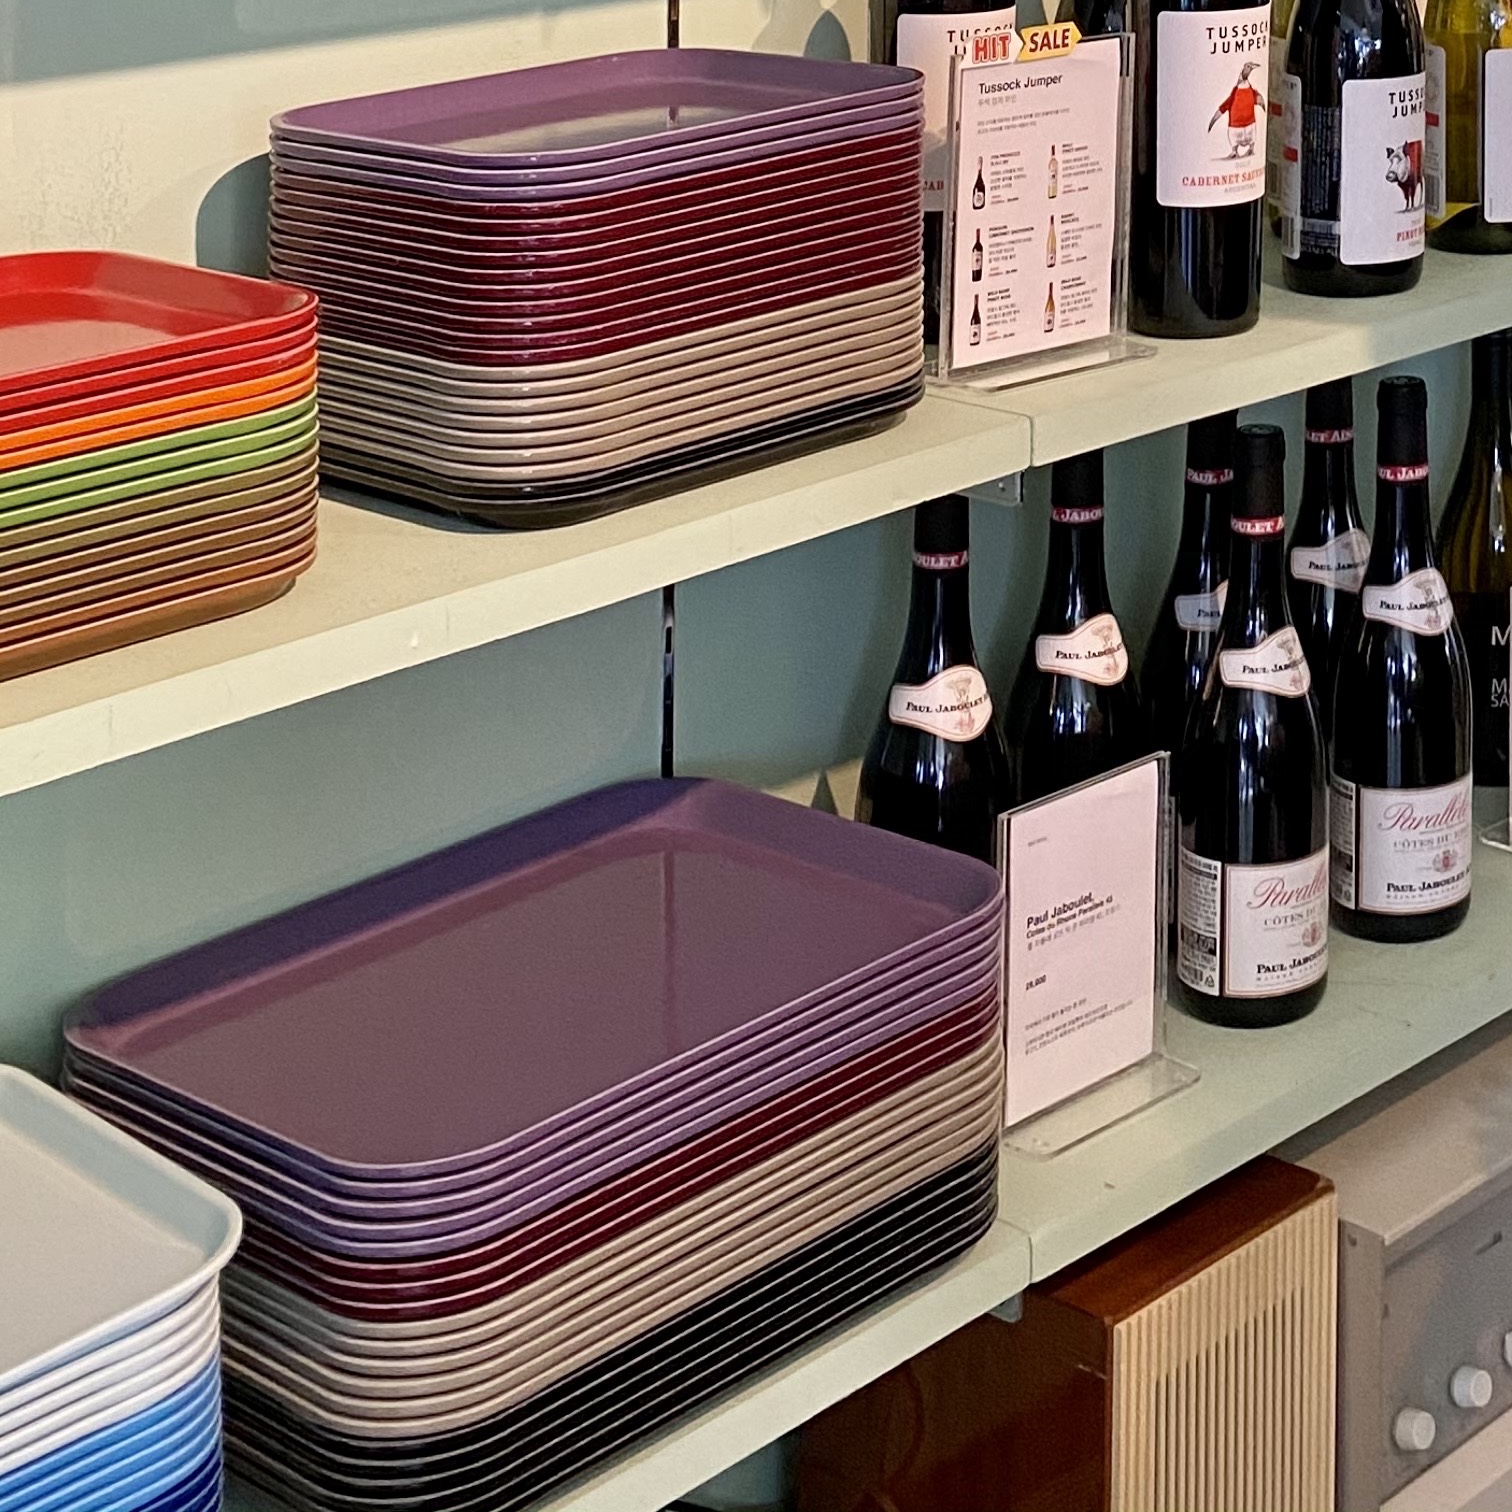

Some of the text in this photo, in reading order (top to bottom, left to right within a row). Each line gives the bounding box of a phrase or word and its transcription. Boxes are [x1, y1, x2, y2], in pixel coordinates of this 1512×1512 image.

[972, 31, 1011, 65] HIT
[1028, 28, 1071, 53] SALE
[978, 74, 1063, 95] Tussock Jumper
[1181, 173, 1240, 187] CABERNET
[1386, 882, 1417, 893] PAUL
[1026, 910, 1049, 929] Paul
[1263, 911, 1304, 926] CÔTES
[1256, 963, 1288, 975] PAUL
